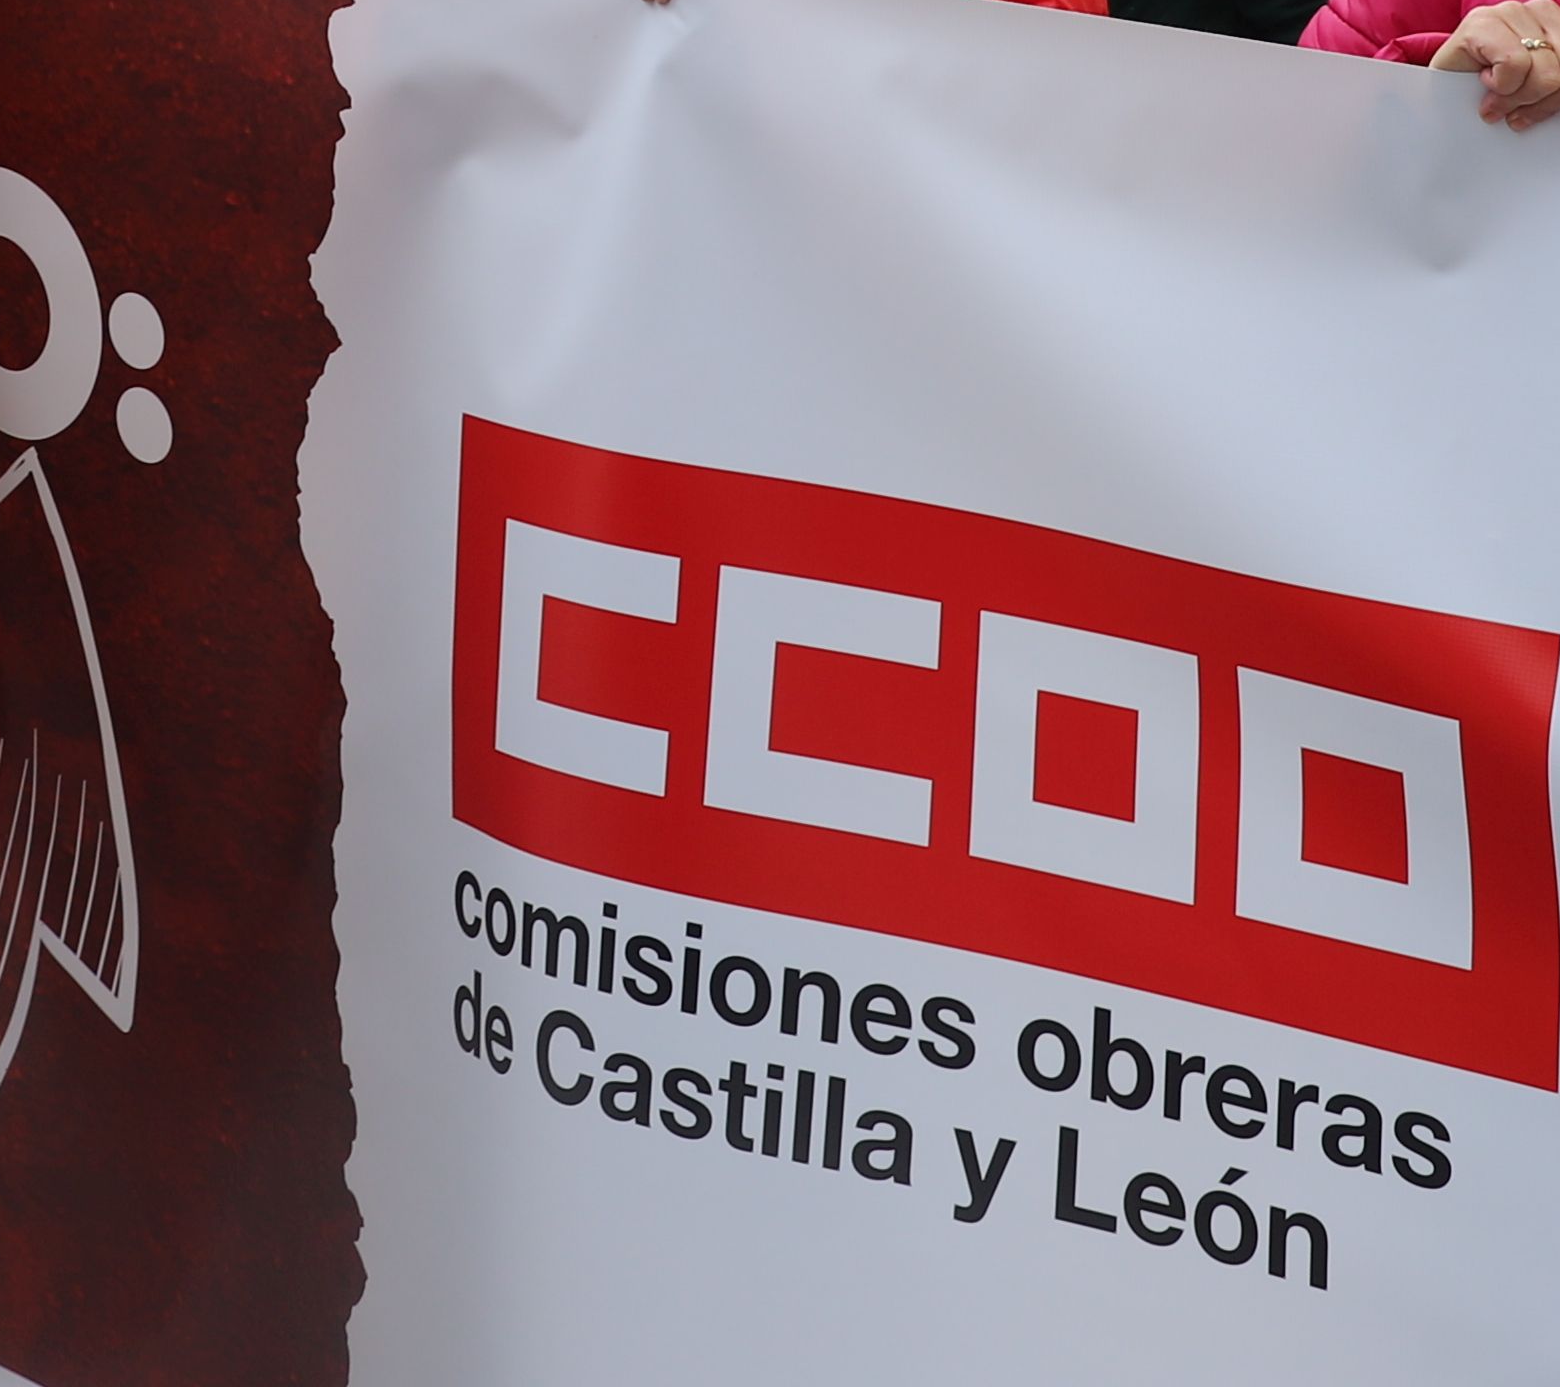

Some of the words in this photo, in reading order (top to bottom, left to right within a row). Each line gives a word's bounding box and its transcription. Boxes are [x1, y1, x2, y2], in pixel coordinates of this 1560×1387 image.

[493, 517, 1474, 970] CCOO
[453, 867, 975, 1071] comisiones
[1018, 1005, 1453, 1190] obreras
[453, 970, 515, 1078] de
[535, 1007, 912, 1187] Castilla
[954, 1129, 1016, 1224] y
[1055, 1125, 1329, 1292] León
